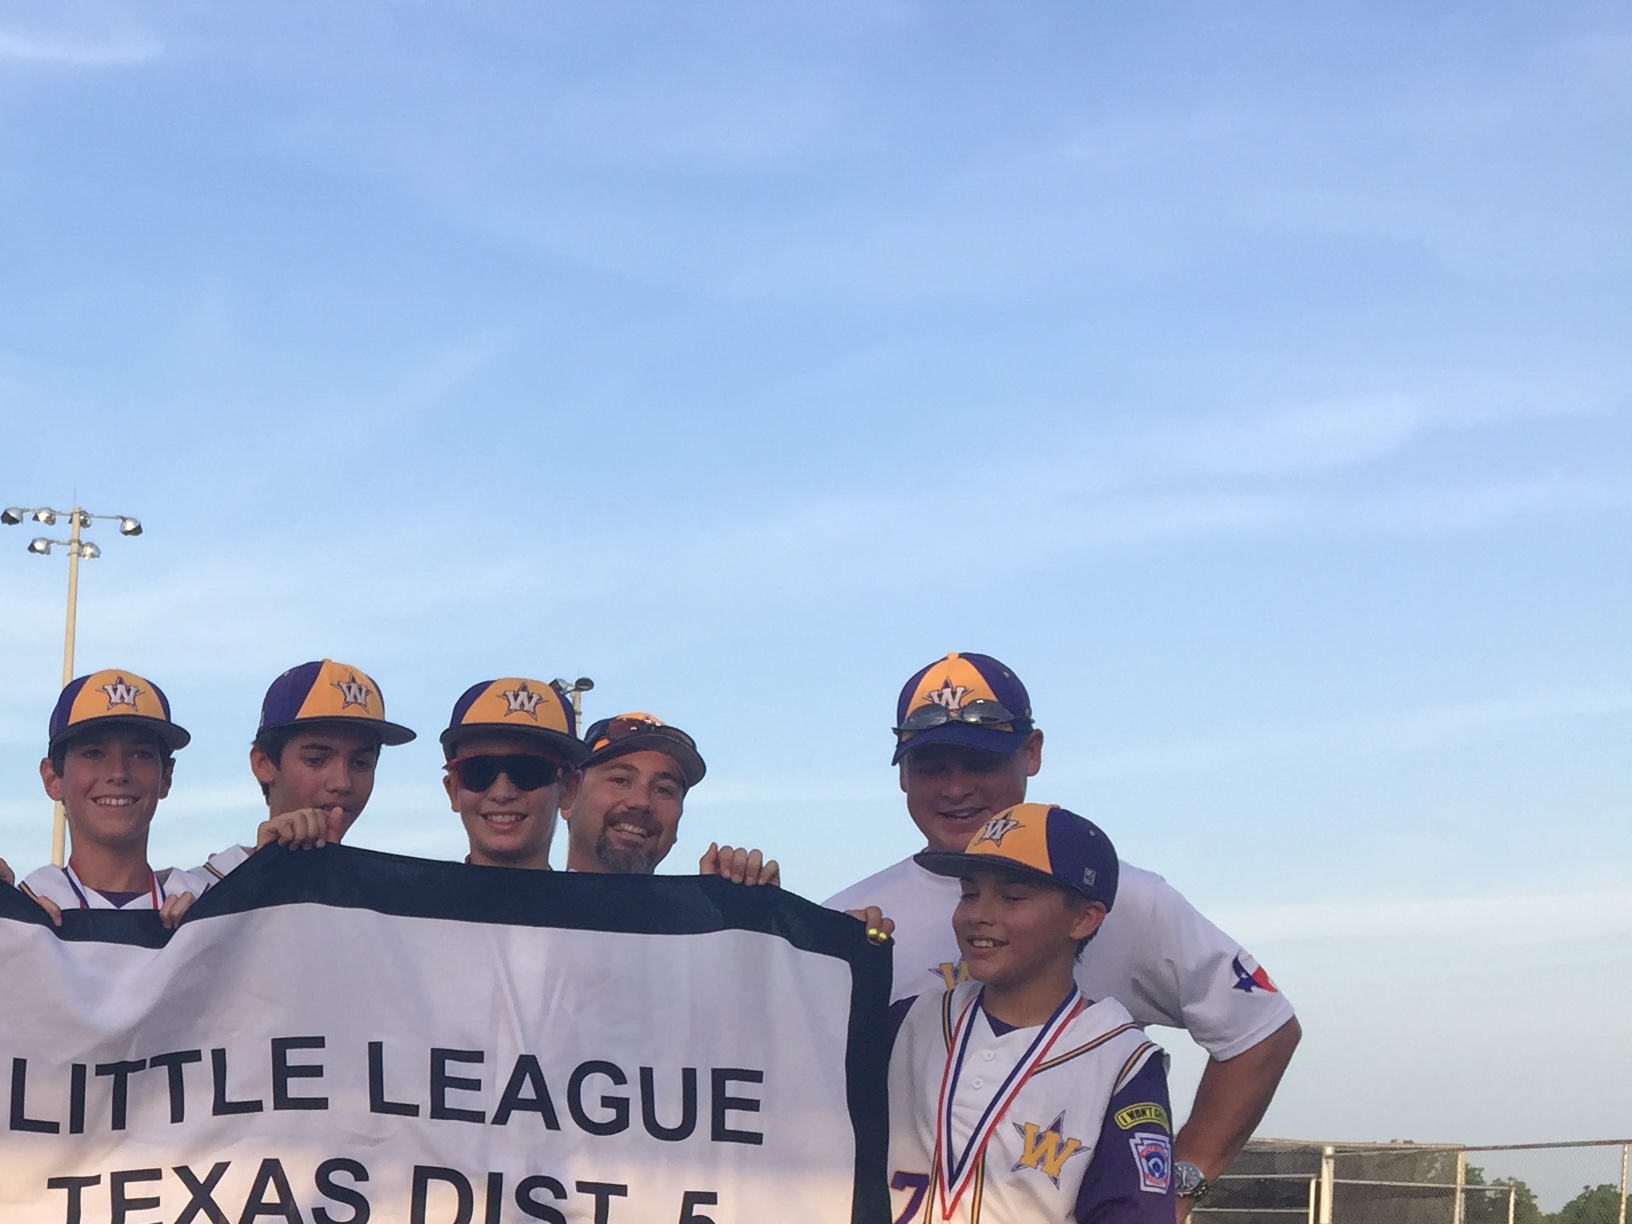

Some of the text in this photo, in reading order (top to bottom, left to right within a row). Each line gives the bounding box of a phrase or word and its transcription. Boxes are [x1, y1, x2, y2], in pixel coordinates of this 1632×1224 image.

[106, 684, 137, 703] W
[340, 684, 367, 703] W
[507, 690, 539, 712] W
[9, 1035, 765, 1145] LITTLE LEAGUE
[1021, 1122, 1081, 1177] W
